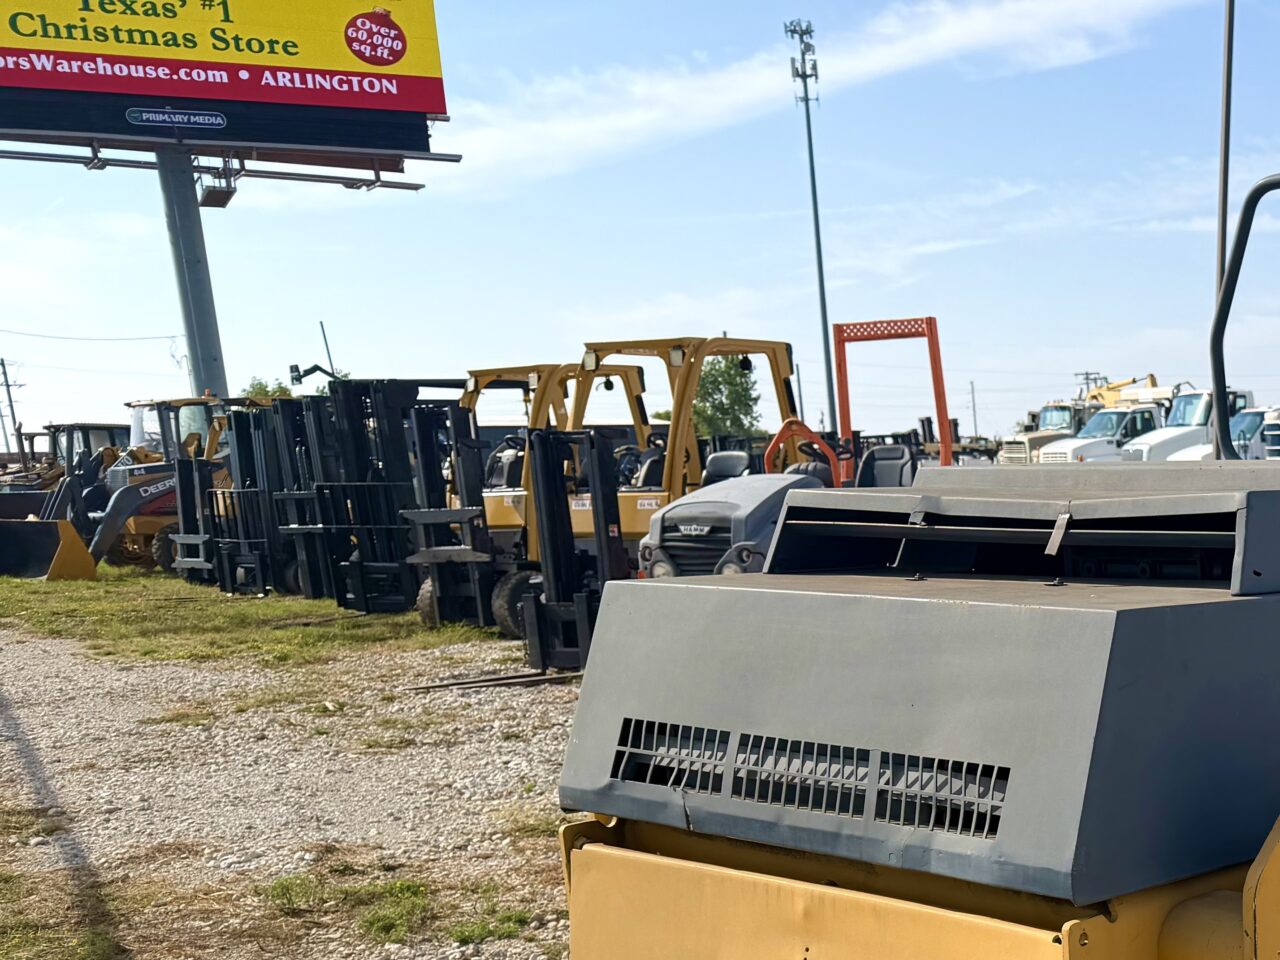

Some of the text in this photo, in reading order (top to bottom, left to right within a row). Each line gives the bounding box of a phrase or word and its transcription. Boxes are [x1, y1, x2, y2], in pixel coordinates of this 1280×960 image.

[8, 11, 300, 56] Christmas Store
[356, 17, 399, 38] Over
[347, 27, 403, 51] 60,000
[351, 41, 394, 60] sq.ft.
[260, 70, 398, 95] ARLINGTON
[142, 113, 224, 125] PRIMARY MEDIA
